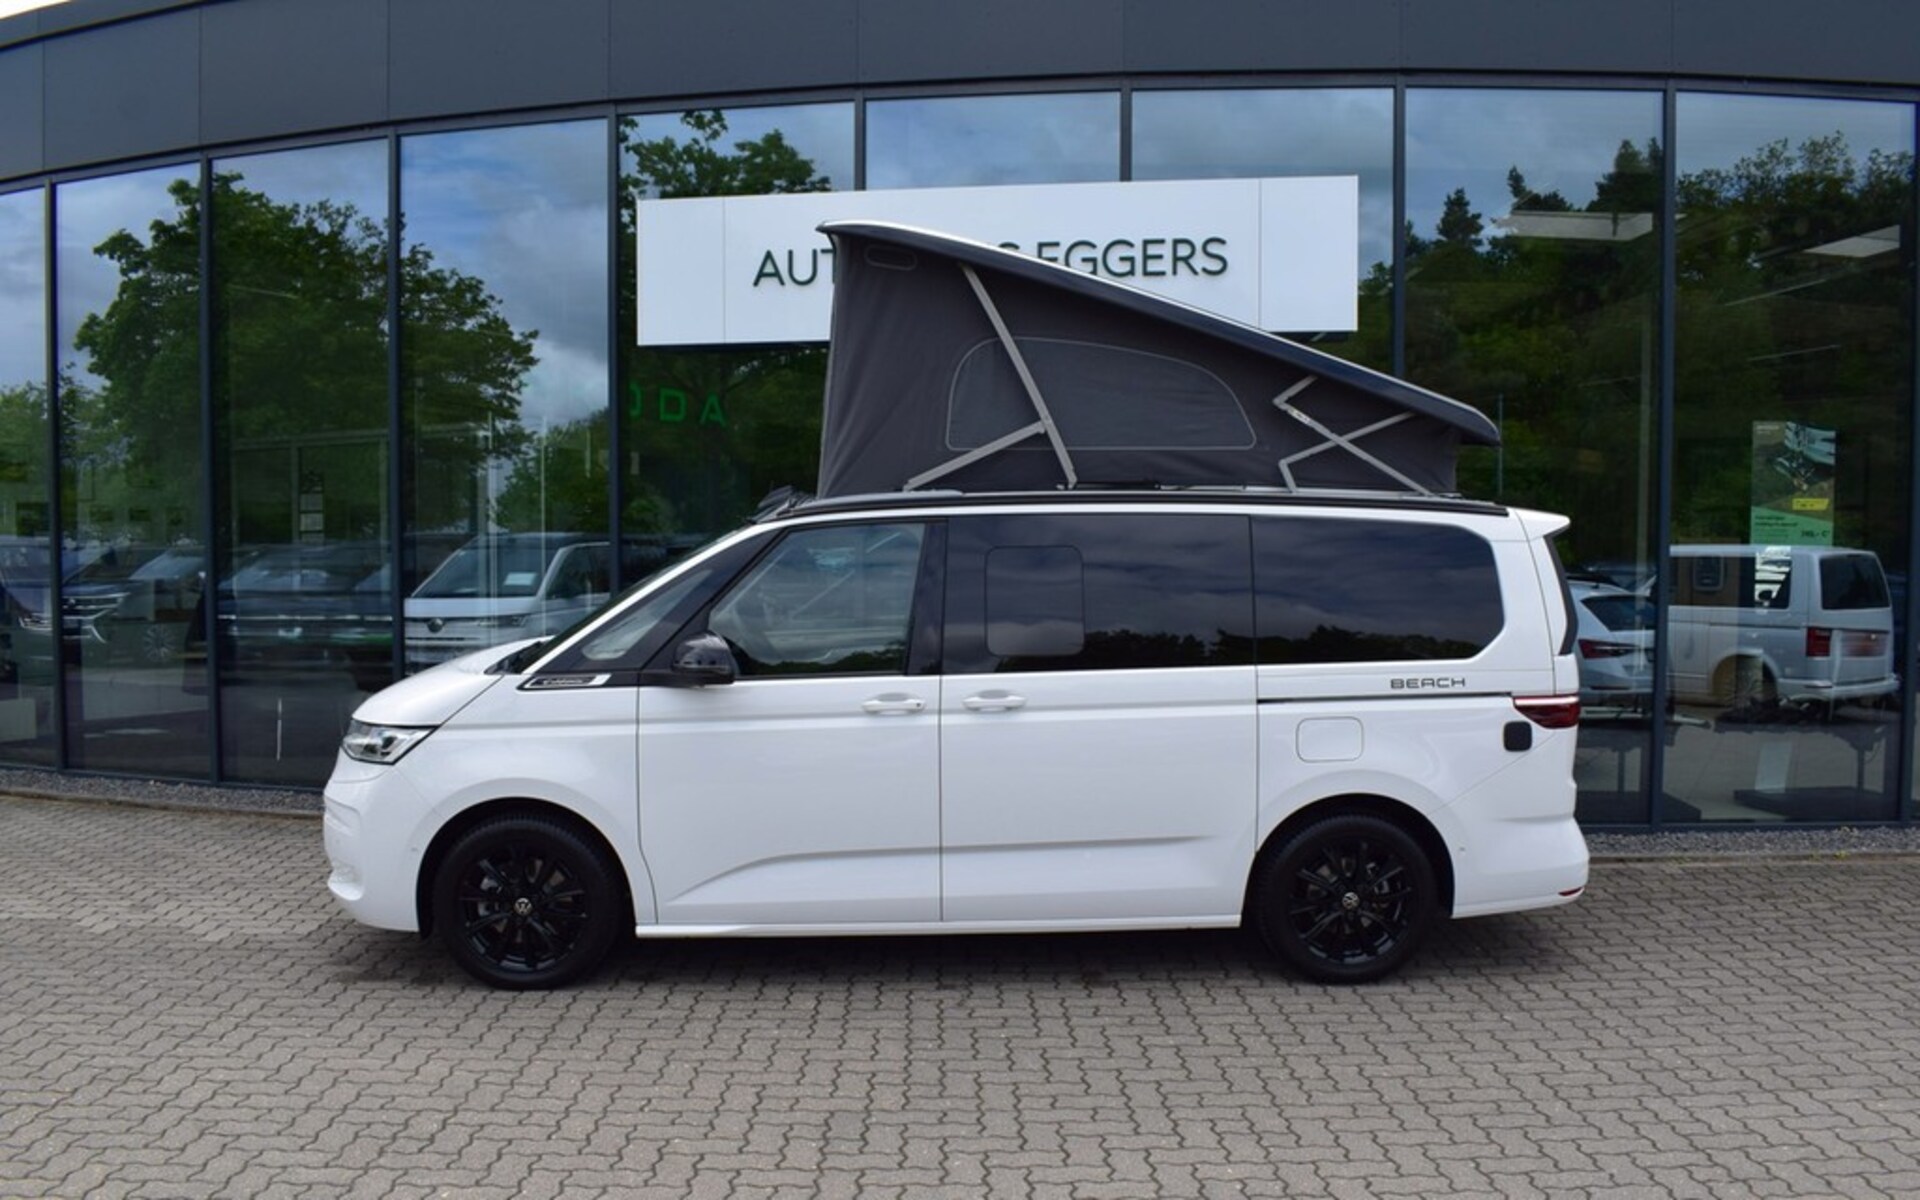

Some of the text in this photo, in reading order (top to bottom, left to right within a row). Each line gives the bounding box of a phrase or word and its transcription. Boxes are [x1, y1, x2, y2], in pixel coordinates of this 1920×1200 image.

[753, 236, 1229, 287] AUT EGGERS
[1390, 677, 1466, 690] BEACH
